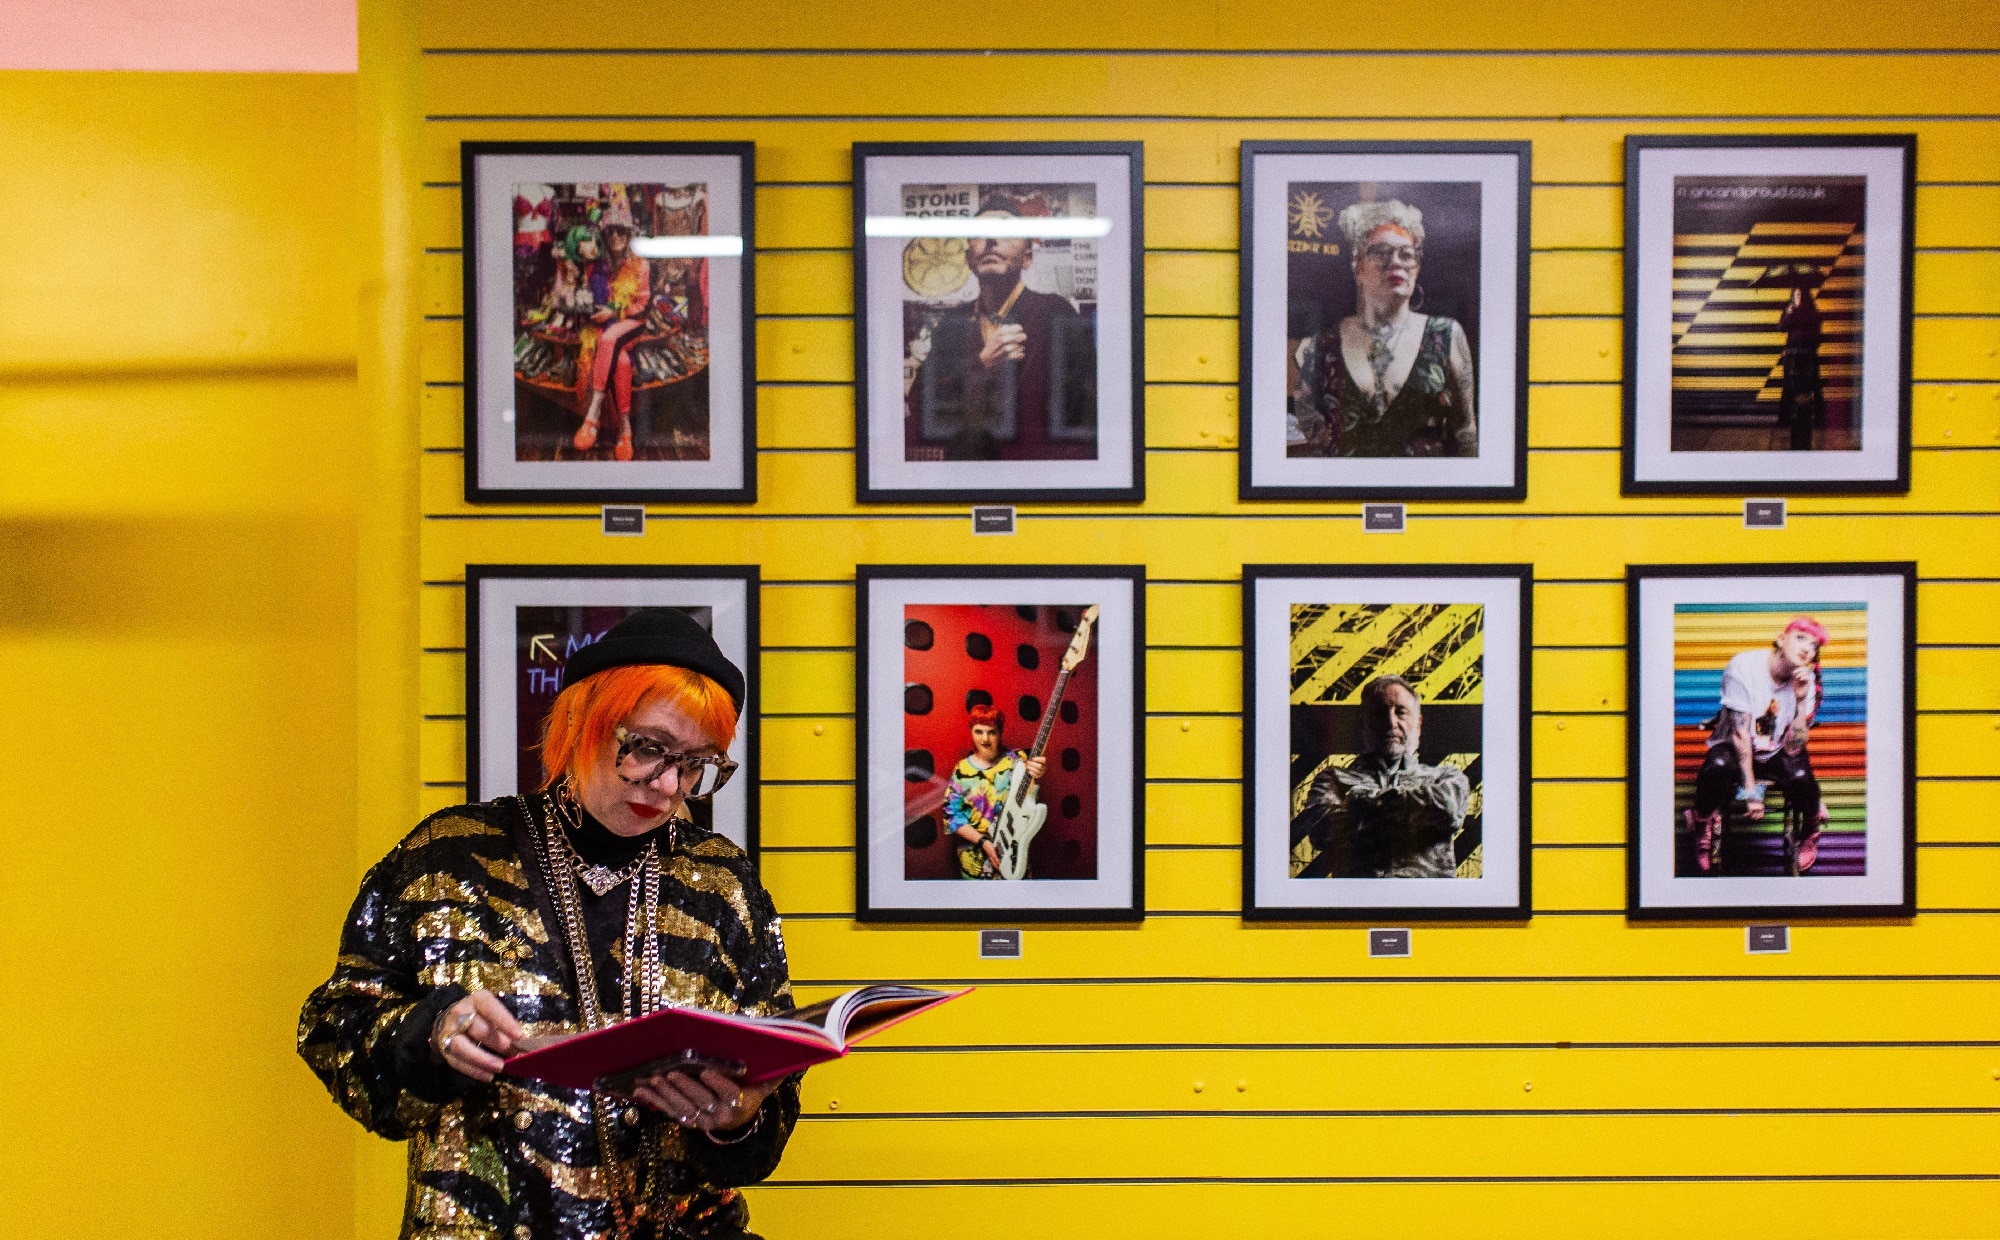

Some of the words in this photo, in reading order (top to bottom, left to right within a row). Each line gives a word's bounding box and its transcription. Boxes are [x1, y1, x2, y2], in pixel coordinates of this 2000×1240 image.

[905, 192, 970, 209] STONE
[565, 630, 608, 659] M
[527, 667, 565, 695] TH
